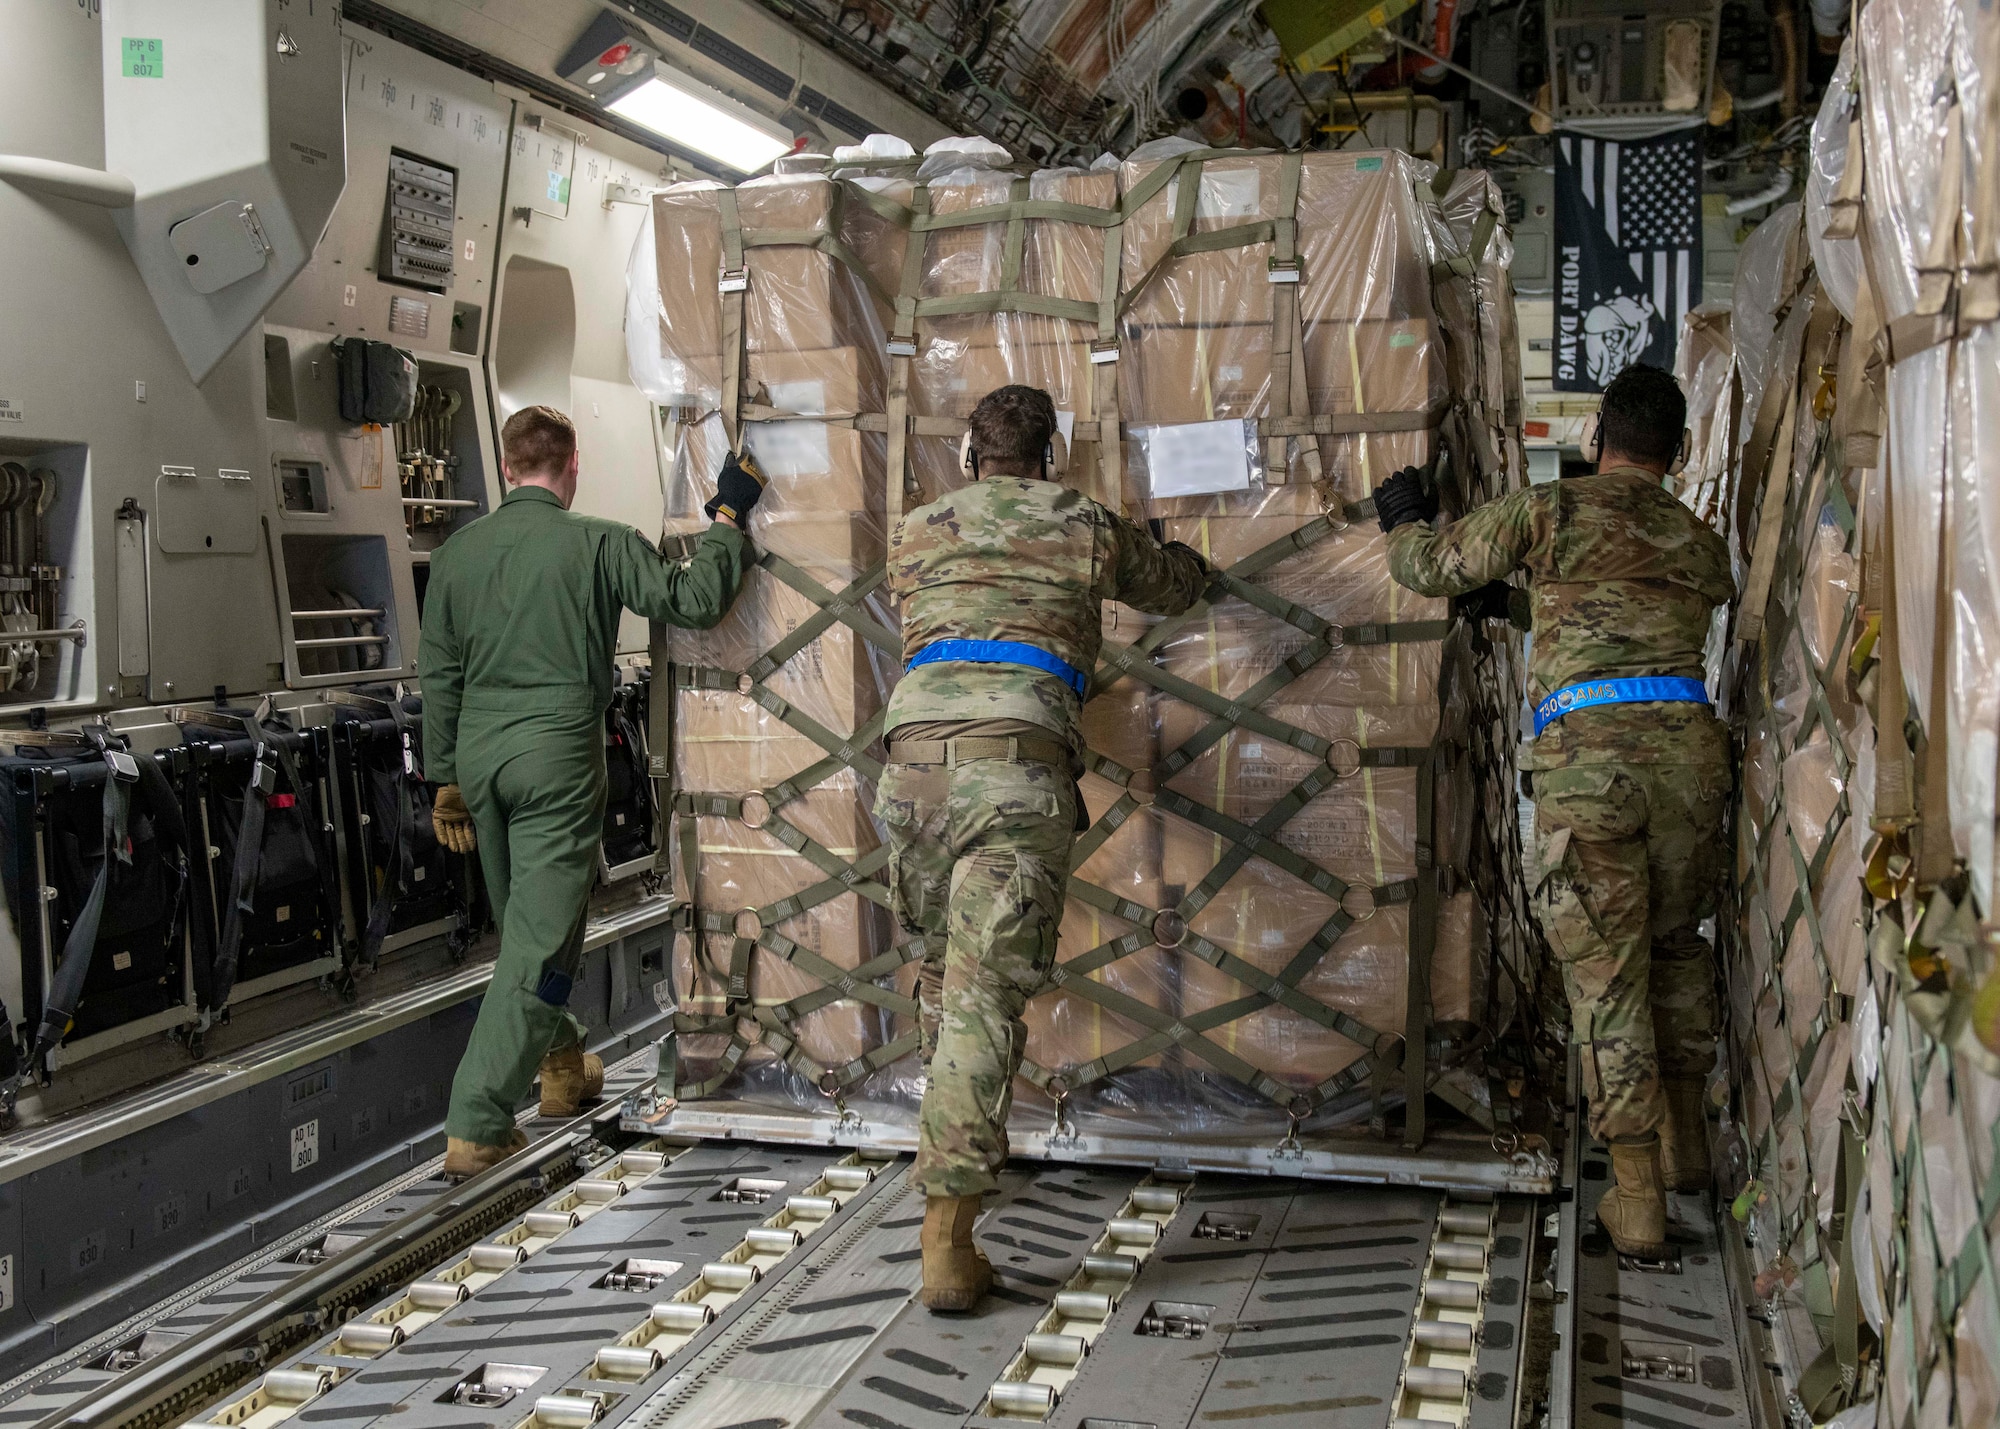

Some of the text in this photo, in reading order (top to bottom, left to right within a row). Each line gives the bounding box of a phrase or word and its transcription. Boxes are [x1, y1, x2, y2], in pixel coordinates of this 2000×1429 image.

[129, 40, 155, 52] PP 6
[133, 64, 153, 76] 807
[381, 81, 396, 103] 760
[429, 102, 443, 121] 750
[474, 119, 486, 138] 740
[552, 148, 563, 167] 720
[1558, 246, 1581, 381] PORT DAWG
[1539, 683, 1616, 721] 730 AMS
[294, 1122, 315, 1143] AD 12
[298, 1147, 312, 1166] 800
[234, 1175, 249, 1195] 810
[162, 1209, 178, 1230] 820
[79, 1245, 98, 1267] 830
